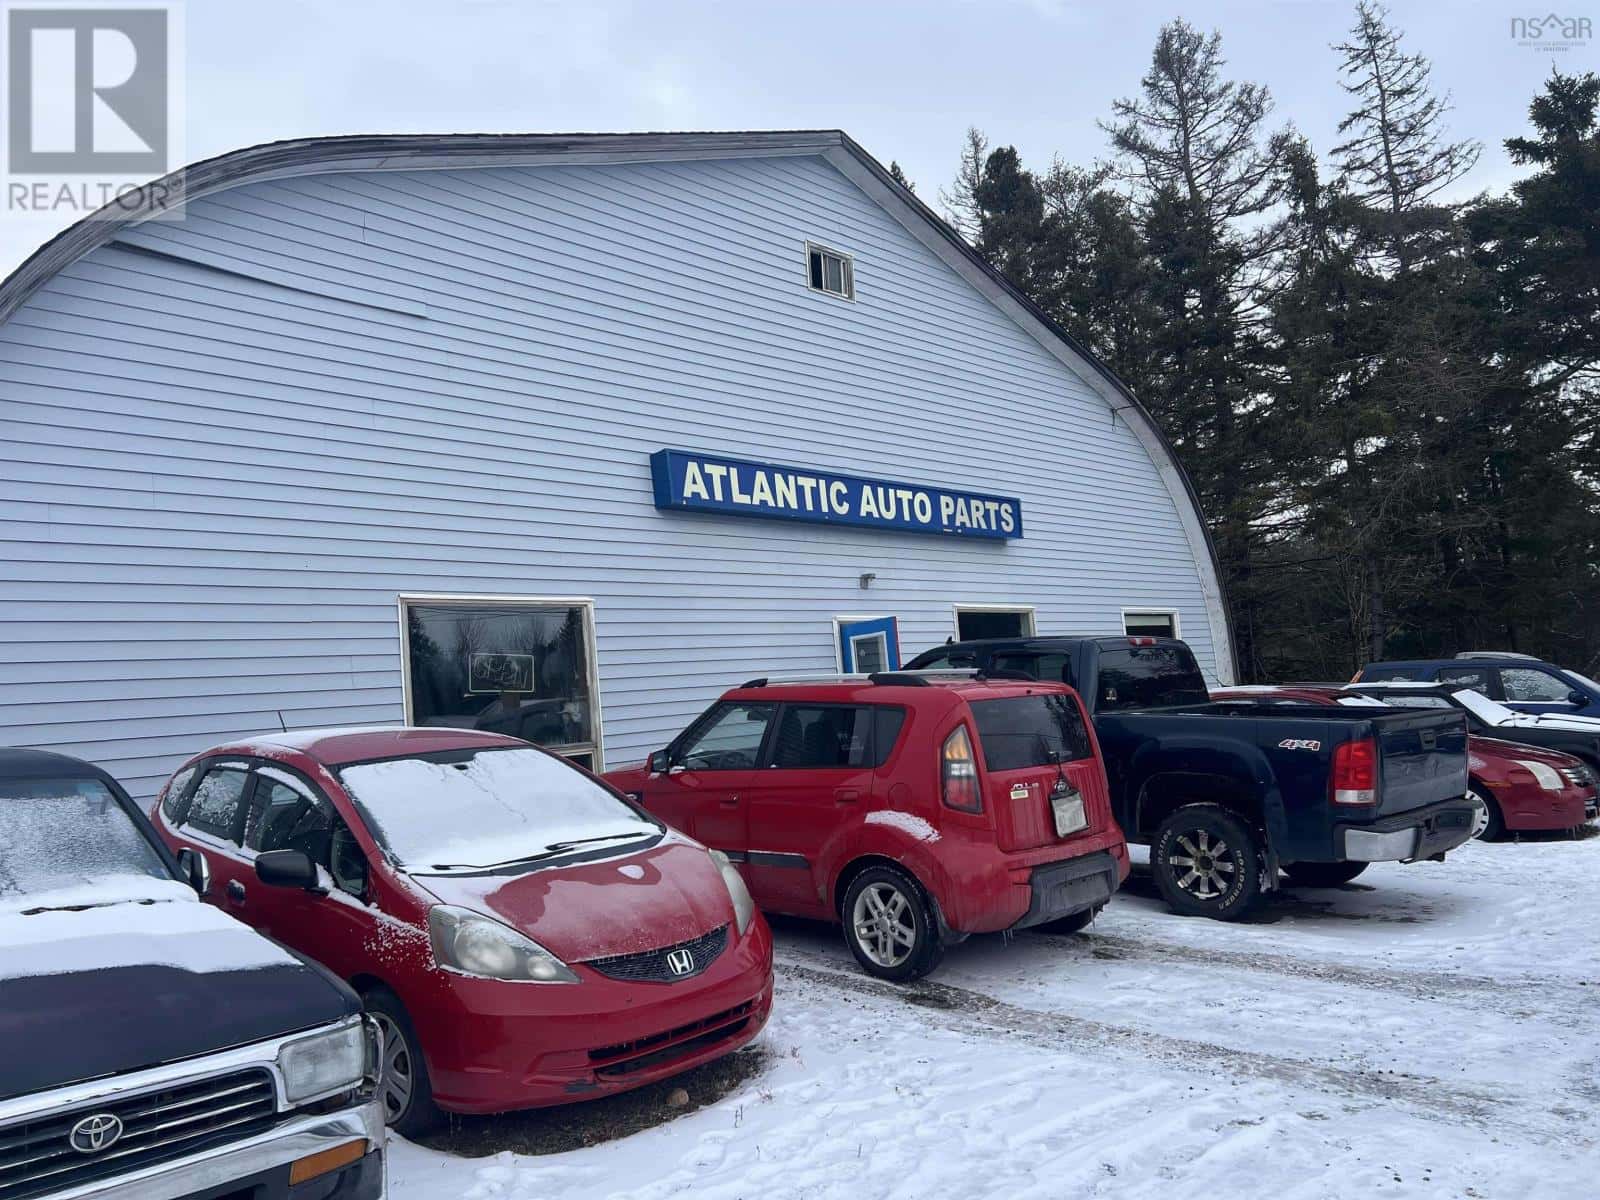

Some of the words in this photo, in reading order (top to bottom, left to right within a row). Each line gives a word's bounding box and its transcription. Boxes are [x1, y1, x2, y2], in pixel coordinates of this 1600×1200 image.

[683, 461, 850, 515] ATLANTIC
[860, 485, 932, 524] AUTO
[940, 495, 1014, 533] PARTS
